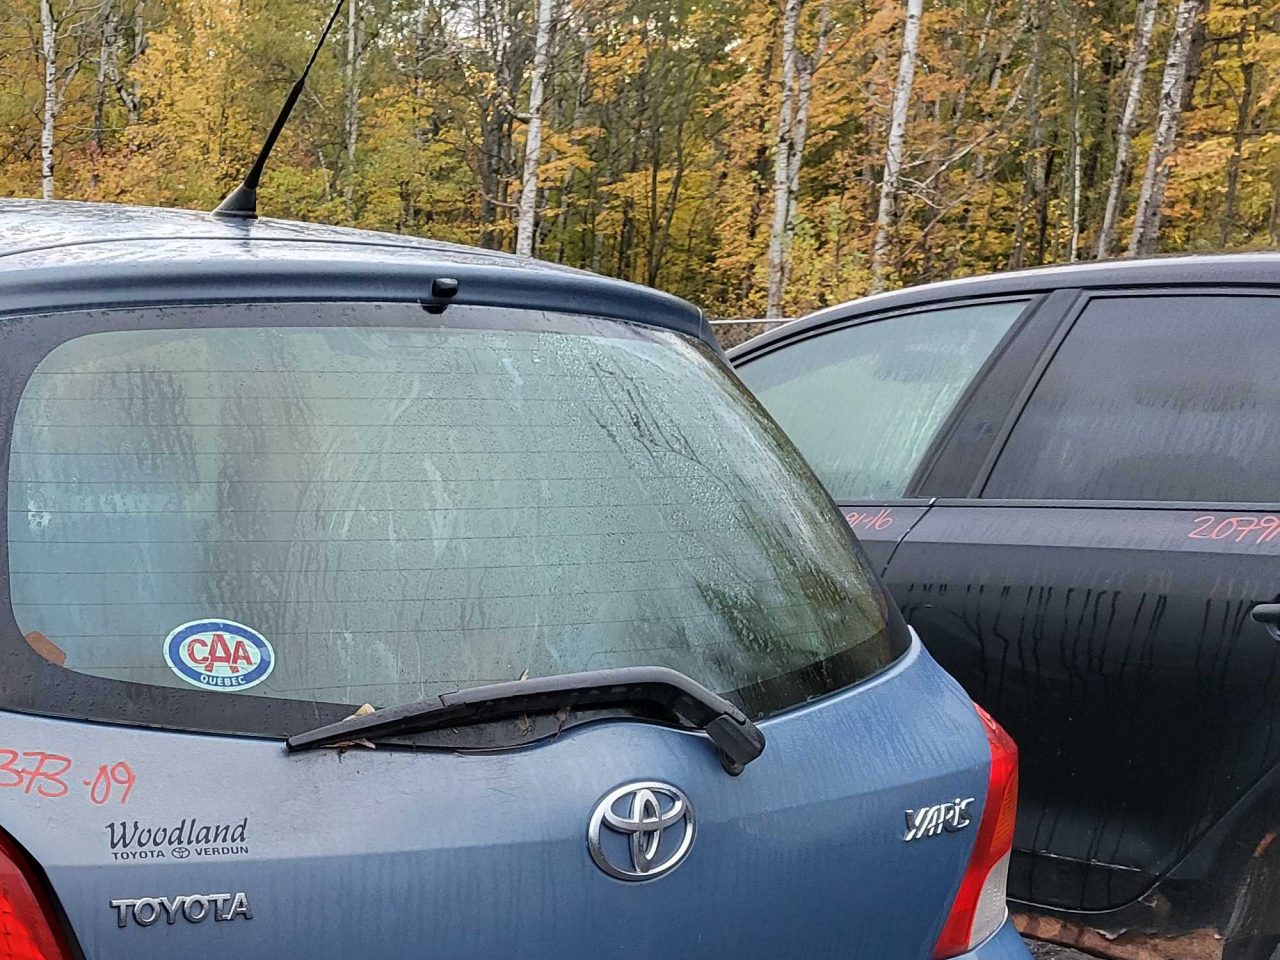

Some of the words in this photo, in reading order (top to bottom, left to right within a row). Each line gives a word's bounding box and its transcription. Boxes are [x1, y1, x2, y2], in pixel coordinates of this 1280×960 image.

[187, 633, 253, 673] CAA
[106, 817, 249, 850] Woodland
[111, 849, 166, 861] TOYOTA
[194, 846, 249, 857] VERDUN
[109, 892, 254, 928] TOYOTA
